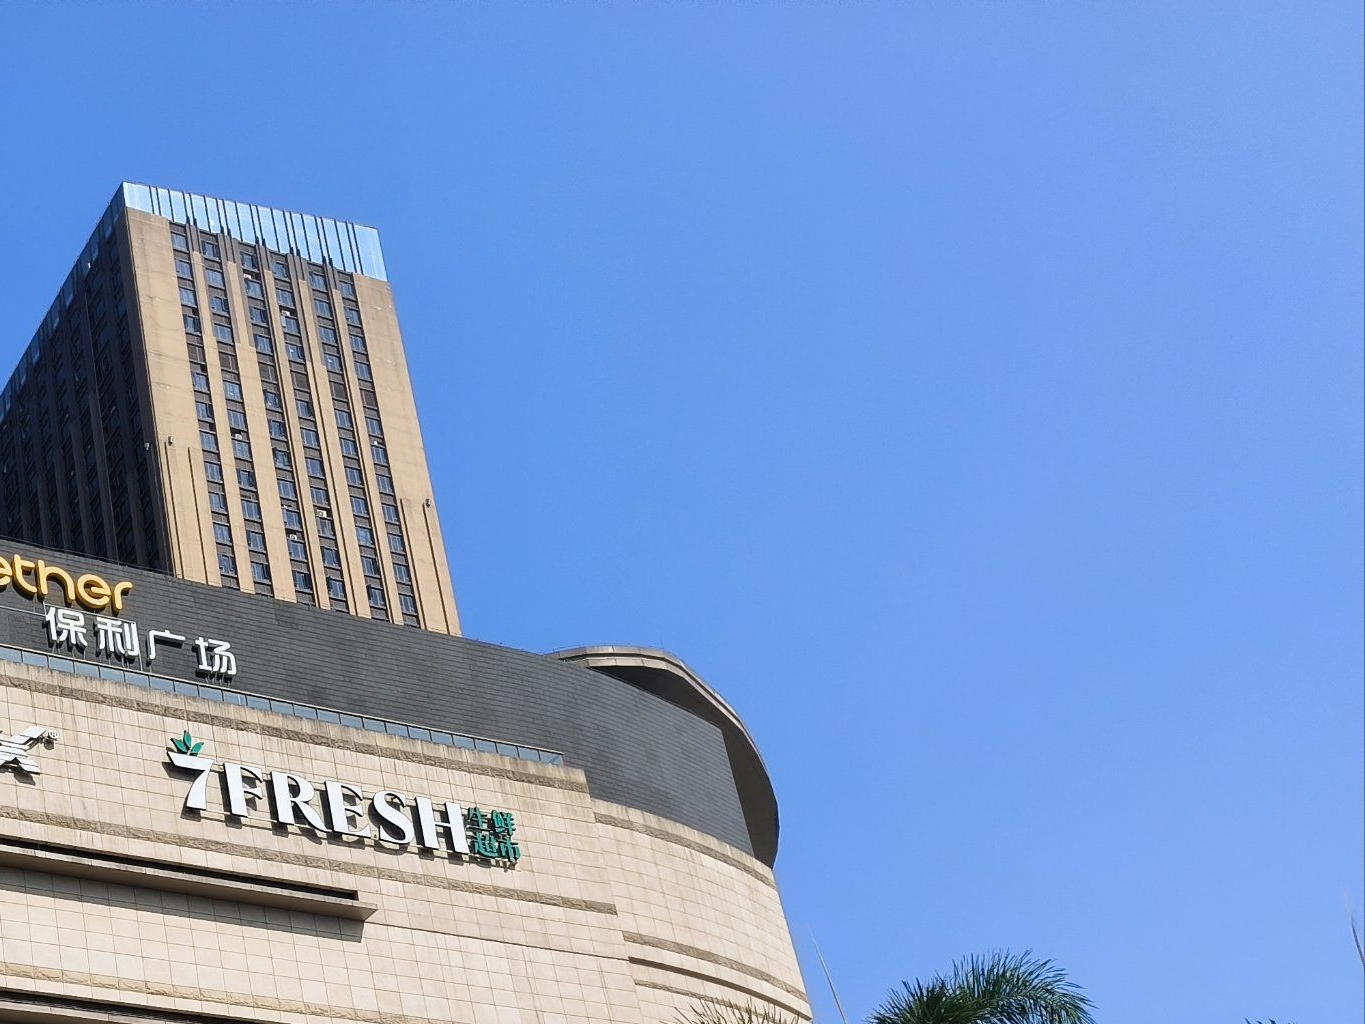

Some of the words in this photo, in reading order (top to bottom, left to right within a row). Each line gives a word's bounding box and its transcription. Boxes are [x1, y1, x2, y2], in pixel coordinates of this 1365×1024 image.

[45, 606, 238, 676] 保利广场
[167, 750, 469, 855] 7FRESH
